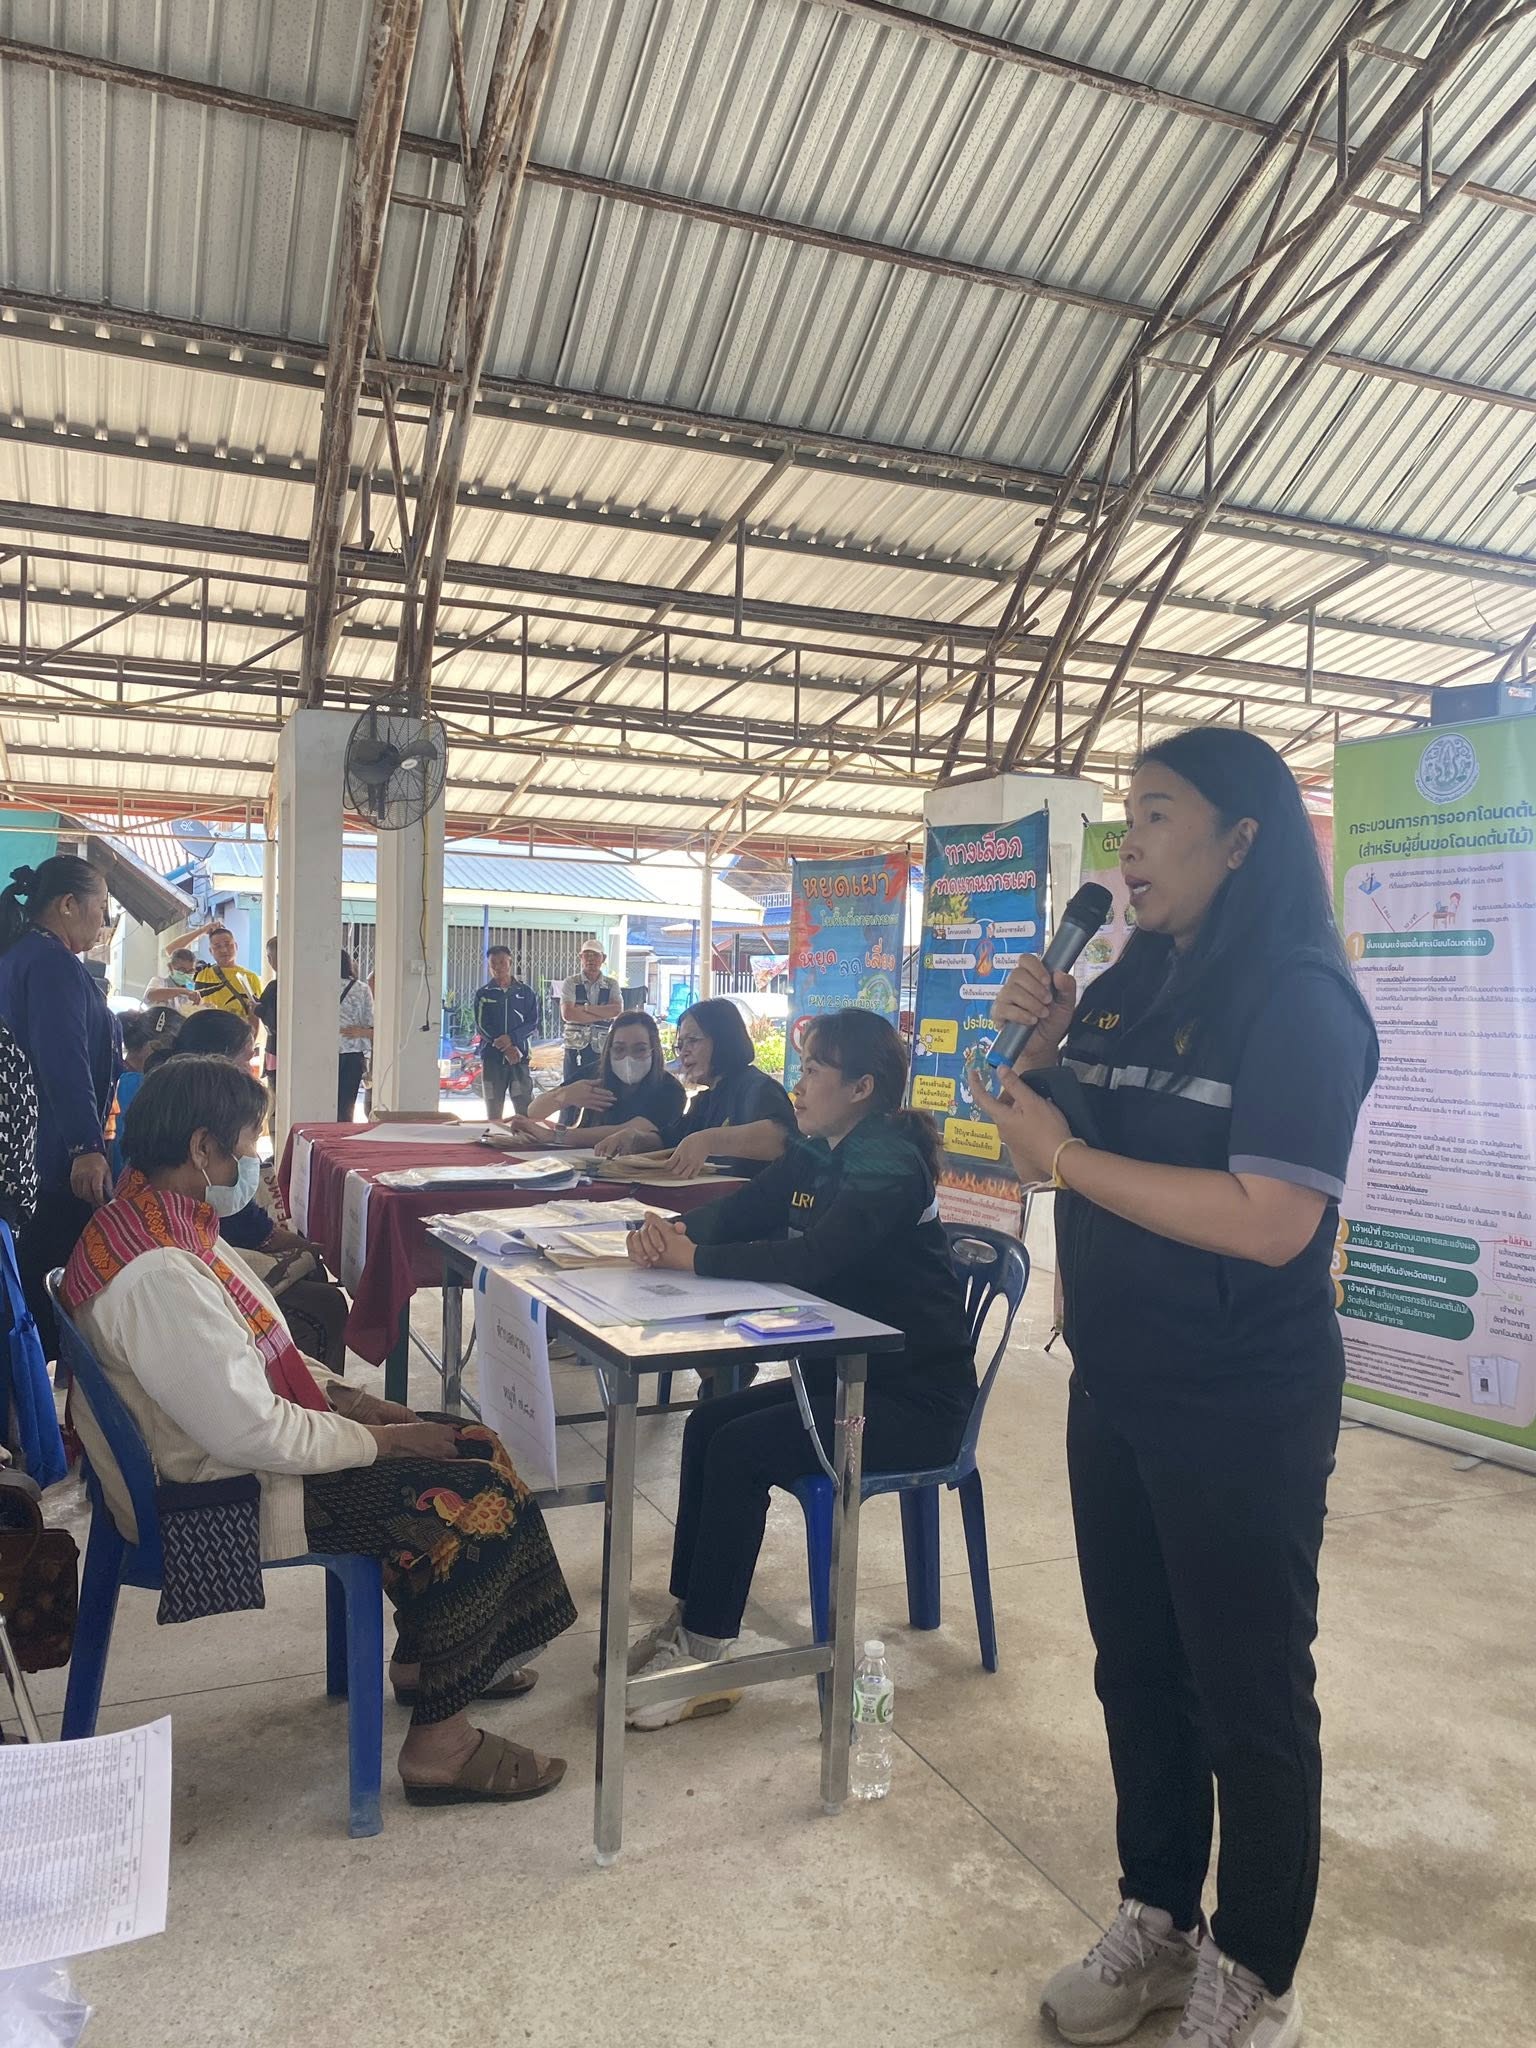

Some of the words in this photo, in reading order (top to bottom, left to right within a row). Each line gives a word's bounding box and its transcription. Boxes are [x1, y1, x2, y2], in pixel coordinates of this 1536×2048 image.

[945, 831, 1023, 866] ทางเลือก
[1358, 826, 1534, 858] (สำหรับผู้ยื่นขอโฉนดต้นไม้)
[802, 872, 890, 910] หยุดเผา
[936, 869, 1037, 896] ทดแทนการเผา
[799, 948, 838, 974] หยุด
[839, 957, 863, 976] ลด
[808, 995, 825, 1008] PM
[827, 995, 841, 1008] 2.5
[1352, 1224, 1381, 1236] เจ้าหน้าที่
[1373, 1239, 1383, 1249] 30
[1347, 1284, 1376, 1296] เจ้าหน้าที่
